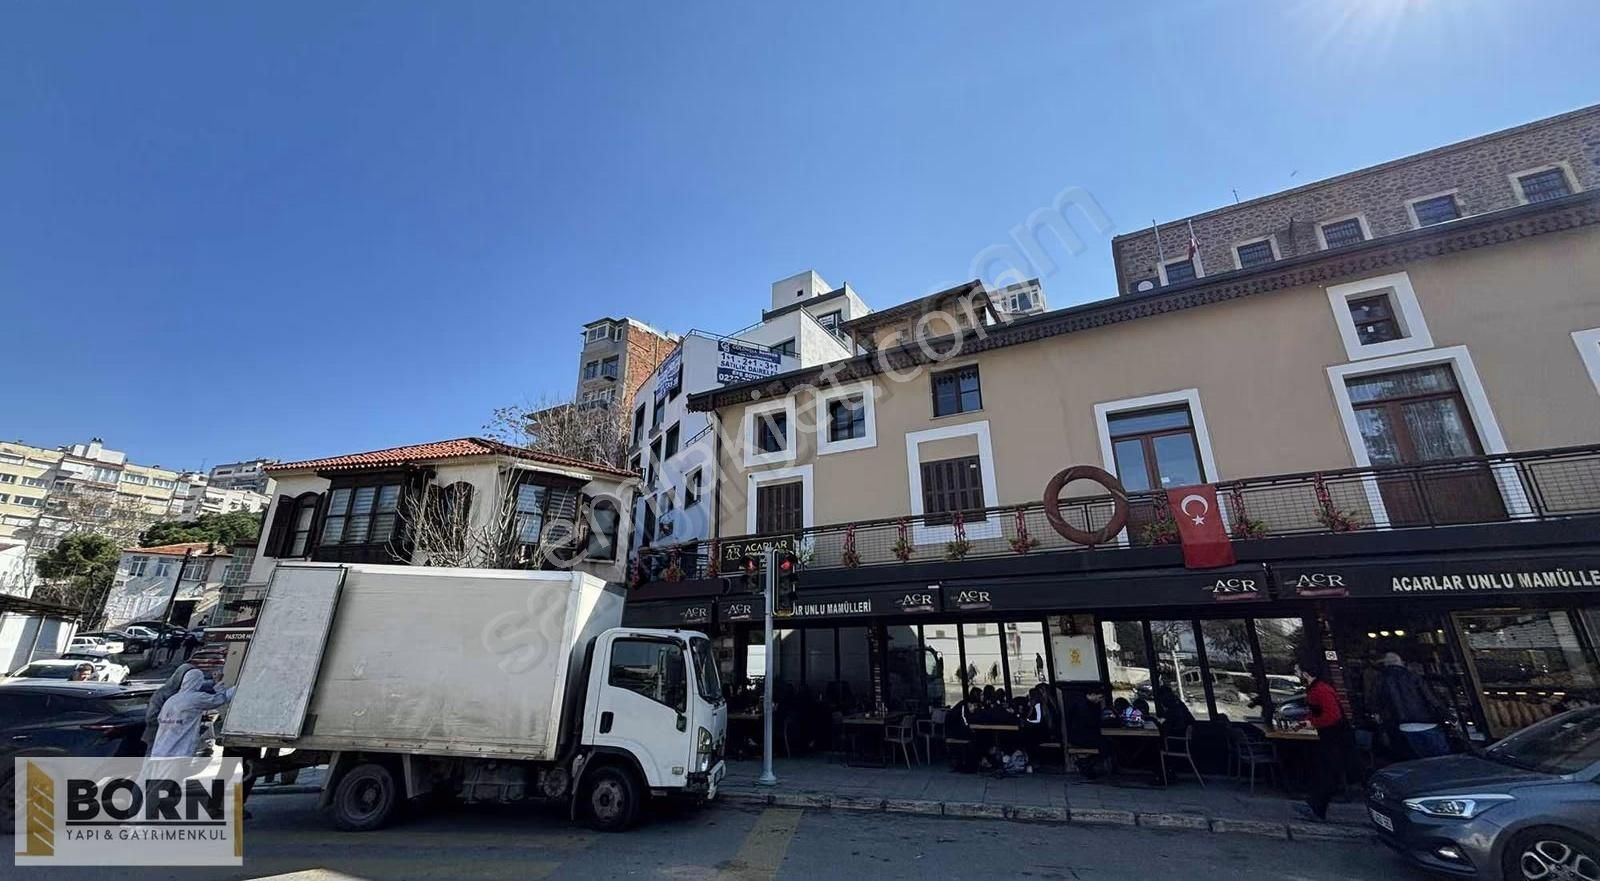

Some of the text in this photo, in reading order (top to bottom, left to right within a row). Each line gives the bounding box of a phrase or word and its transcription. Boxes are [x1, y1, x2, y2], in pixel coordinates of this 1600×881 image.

[742, 358, 757, 367] 2+1
[765, 362, 778, 371] 3+1
[1213, 578, 1258, 593] ACR
[1296, 573, 1346, 588] ACR
[1392, 575, 1464, 592] ACARLAR
[1466, 573, 1514, 590] UNLU
[902, 593, 933, 606] ACR
[957, 590, 991, 603] ACR
[684, 607, 707, 617] ACR
[728, 603, 752, 615] ACR
[804, 603, 826, 616] UNLU
